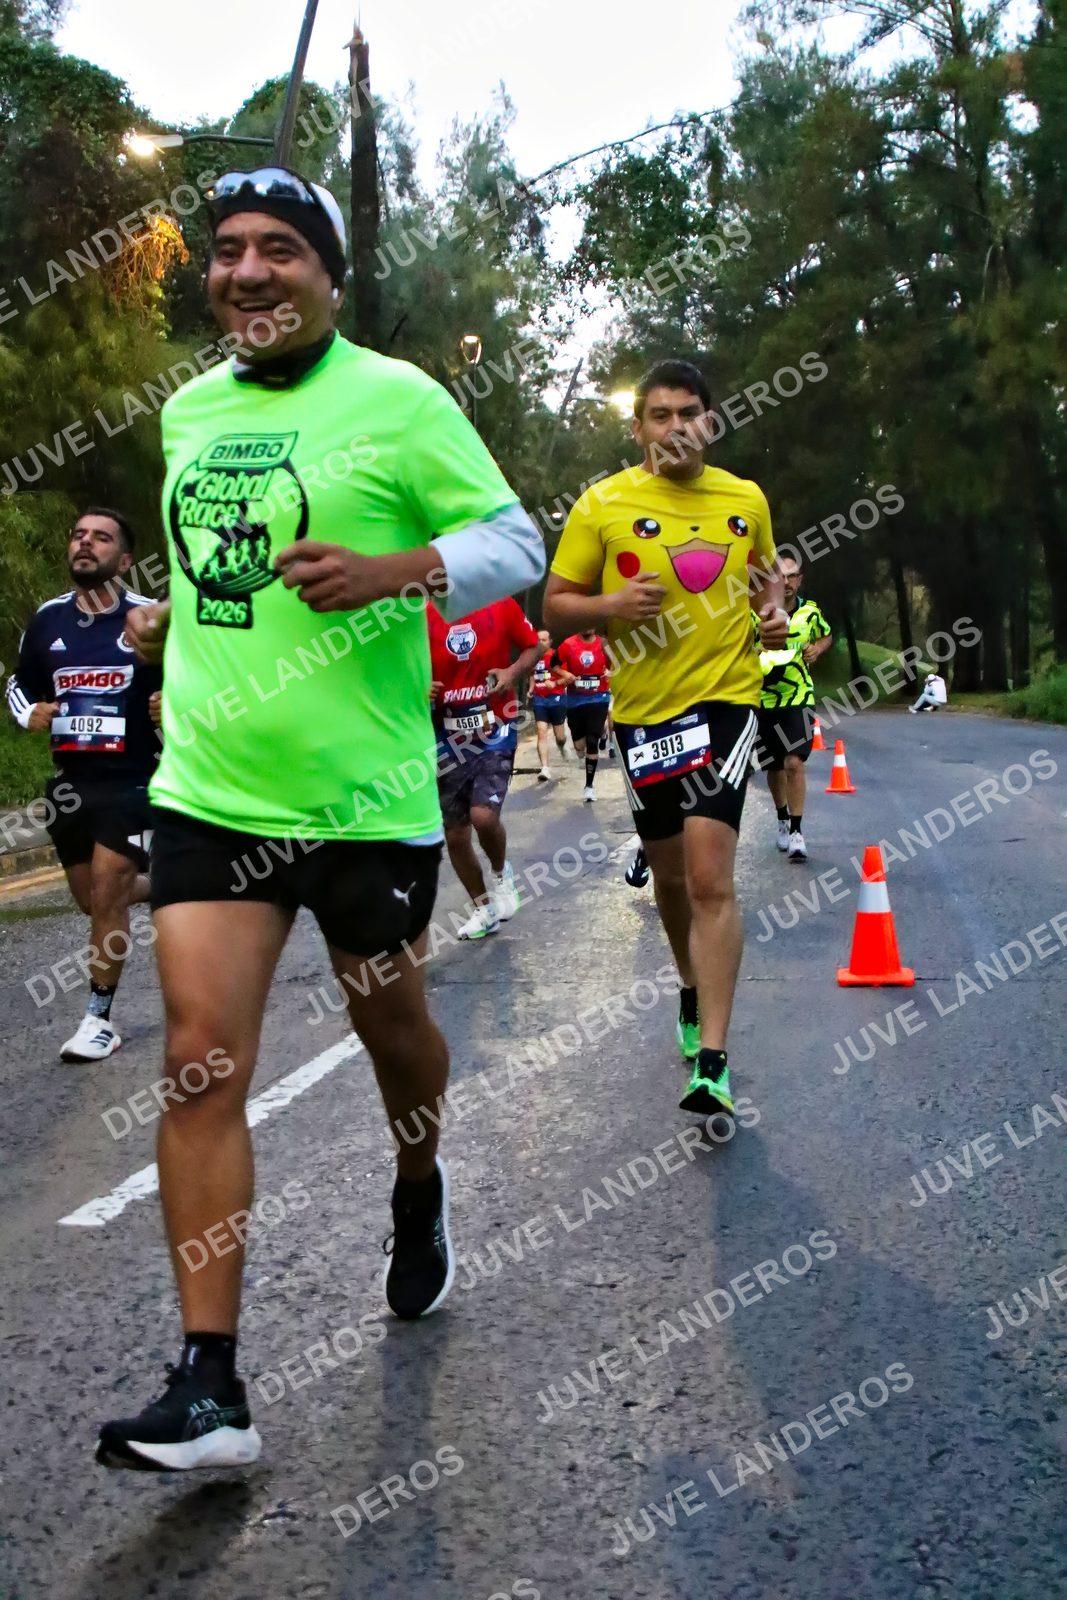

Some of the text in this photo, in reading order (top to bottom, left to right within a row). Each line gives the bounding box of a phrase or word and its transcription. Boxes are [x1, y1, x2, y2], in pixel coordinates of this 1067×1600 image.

[208, 442, 284, 460] BIMBO
[195, 469, 274, 501] Global
[178, 496, 241, 528] Race
[200, 597, 248, 624] 2026
[58, 671, 126, 689] BIMBO
[70, 717, 103, 733] 4092
[456, 715, 480, 730] 4568
[651, 734, 684, 760] 3913
